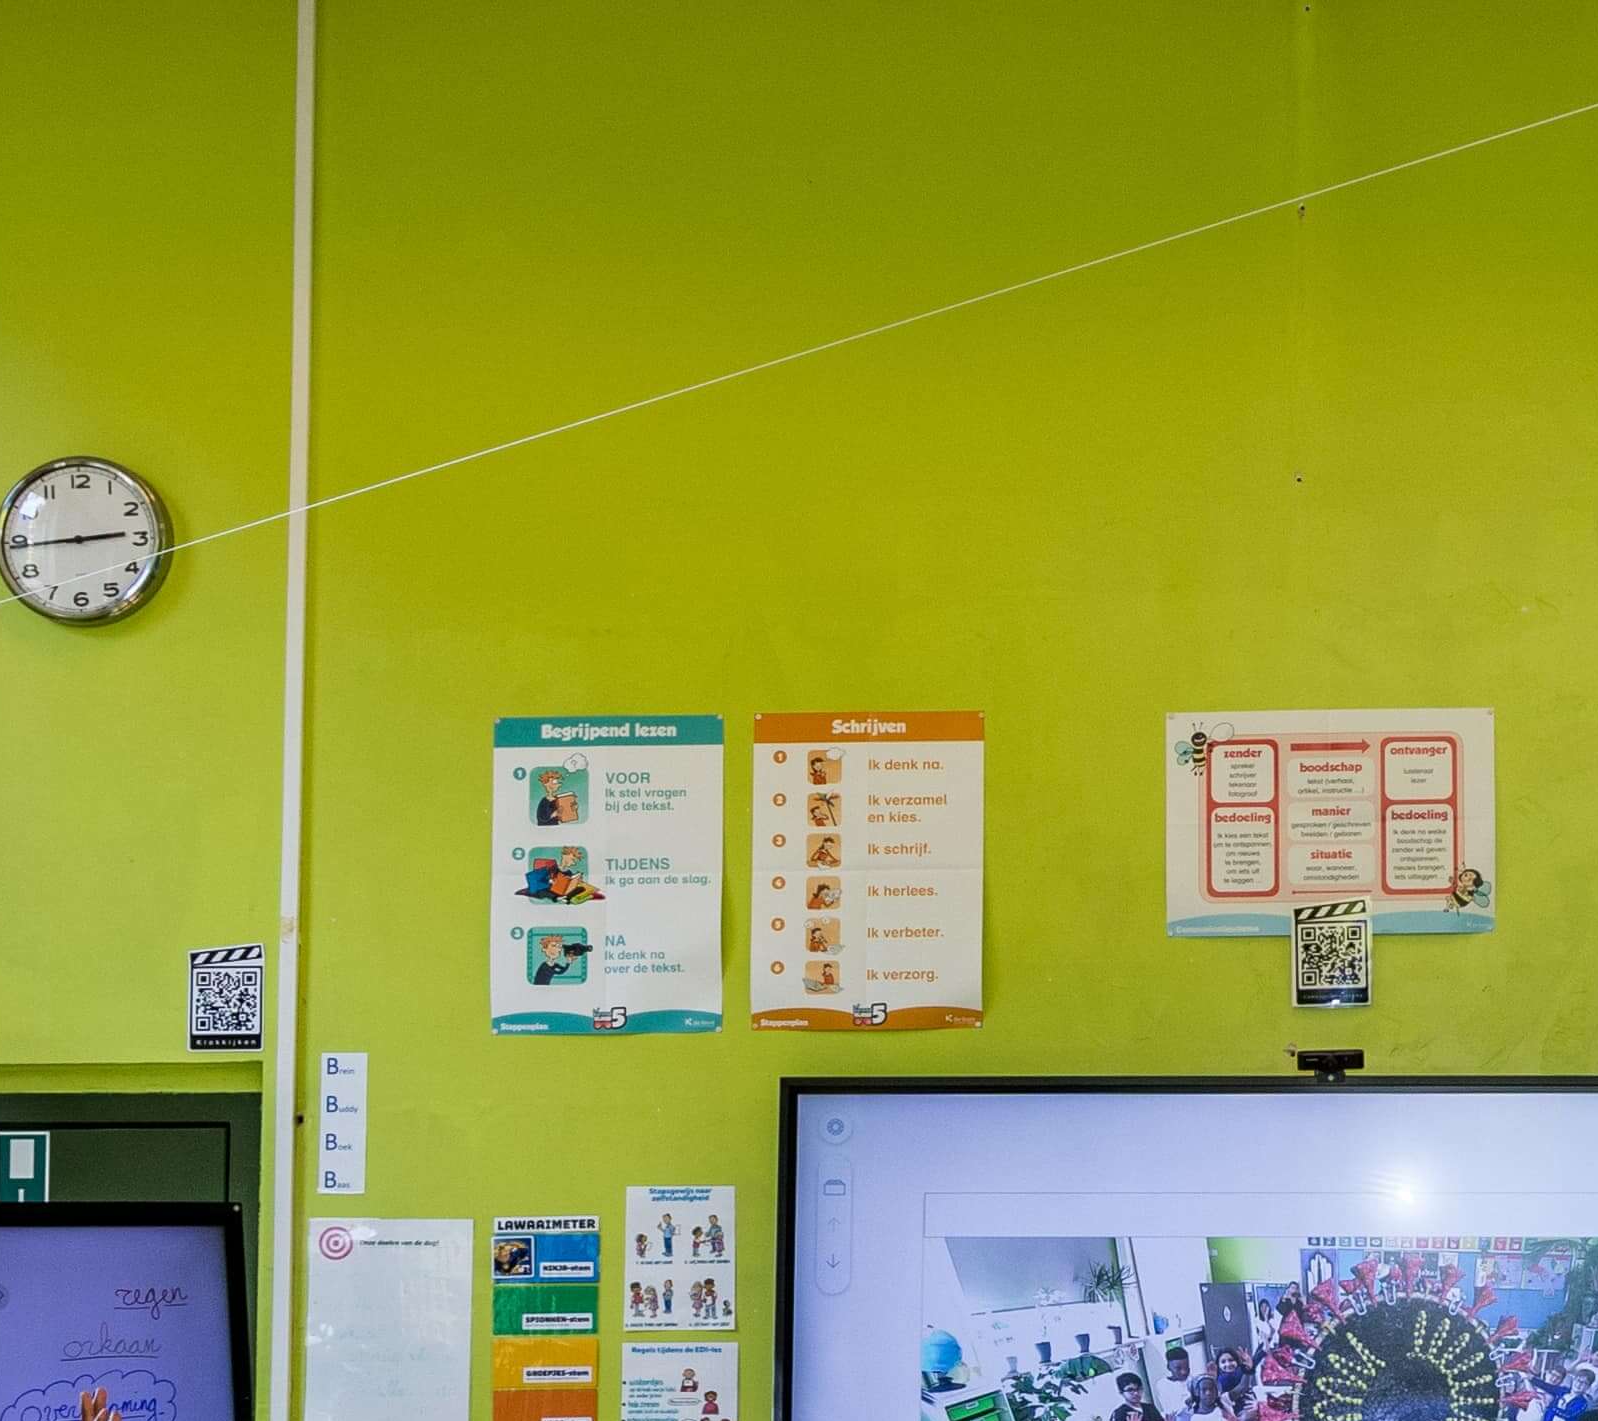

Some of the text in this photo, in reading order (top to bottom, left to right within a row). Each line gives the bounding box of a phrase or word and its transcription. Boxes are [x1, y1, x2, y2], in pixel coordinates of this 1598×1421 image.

[71, 474, 90, 489] 12
[108, 481, 112, 494] 1
[44, 485, 55, 499] 11
[124, 502, 139, 516] 2
[133, 531, 148, 546] 3
[22, 564, 39, 577] 8
[125, 561, 139, 574] 4
[103, 583, 119, 597] 5
[74, 592, 89, 606] 6
[541, 723, 677, 741] Begrijpend lezen
[832, 719, 906, 736] Schrijven
[1224, 748, 1263, 759] zender
[1390, 744, 1448, 756] ontvanger
[868, 759, 944, 770] Ik denk na.
[1299, 762, 1362, 773] boodschap
[606, 772, 650, 784] VOOR
[605, 788, 686, 800] Ik stel vragen
[868, 794, 947, 806] Ik verzamel
[605, 801, 674, 812] bij de tekst.
[1312, 805, 1351, 816] manier
[868, 811, 921, 823] en kies.
[1214, 812, 1271, 824] bedoeling
[1391, 809, 1448, 821] bedoeling
[868, 842, 931, 857] Ik schrijf.
[1310, 848, 1353, 860] situatie
[606, 858, 670, 870] TIJDENS
[606, 874, 711, 887] Ik ga aan de slag.
[868, 885, 938, 897] Ik herlees.
[867, 927, 944, 939] Ik verbeter.
[605, 936, 626, 946] NA
[604, 950, 665, 960] Ik denk na
[604, 963, 685, 974] over de tekst.
[867, 969, 938, 983] Ik verzorg.
[327, 1058, 354, 1074] Brein
[326, 1096, 358, 1113] Buddy
[325, 1134, 352, 1150] Boek
[324, 1171, 350, 1188] Baas
[497, 1219, 595, 1230] LAWAAIMETER
[115, 1287, 187, 1320] regen
[63, 1322, 161, 1358] orkaan
